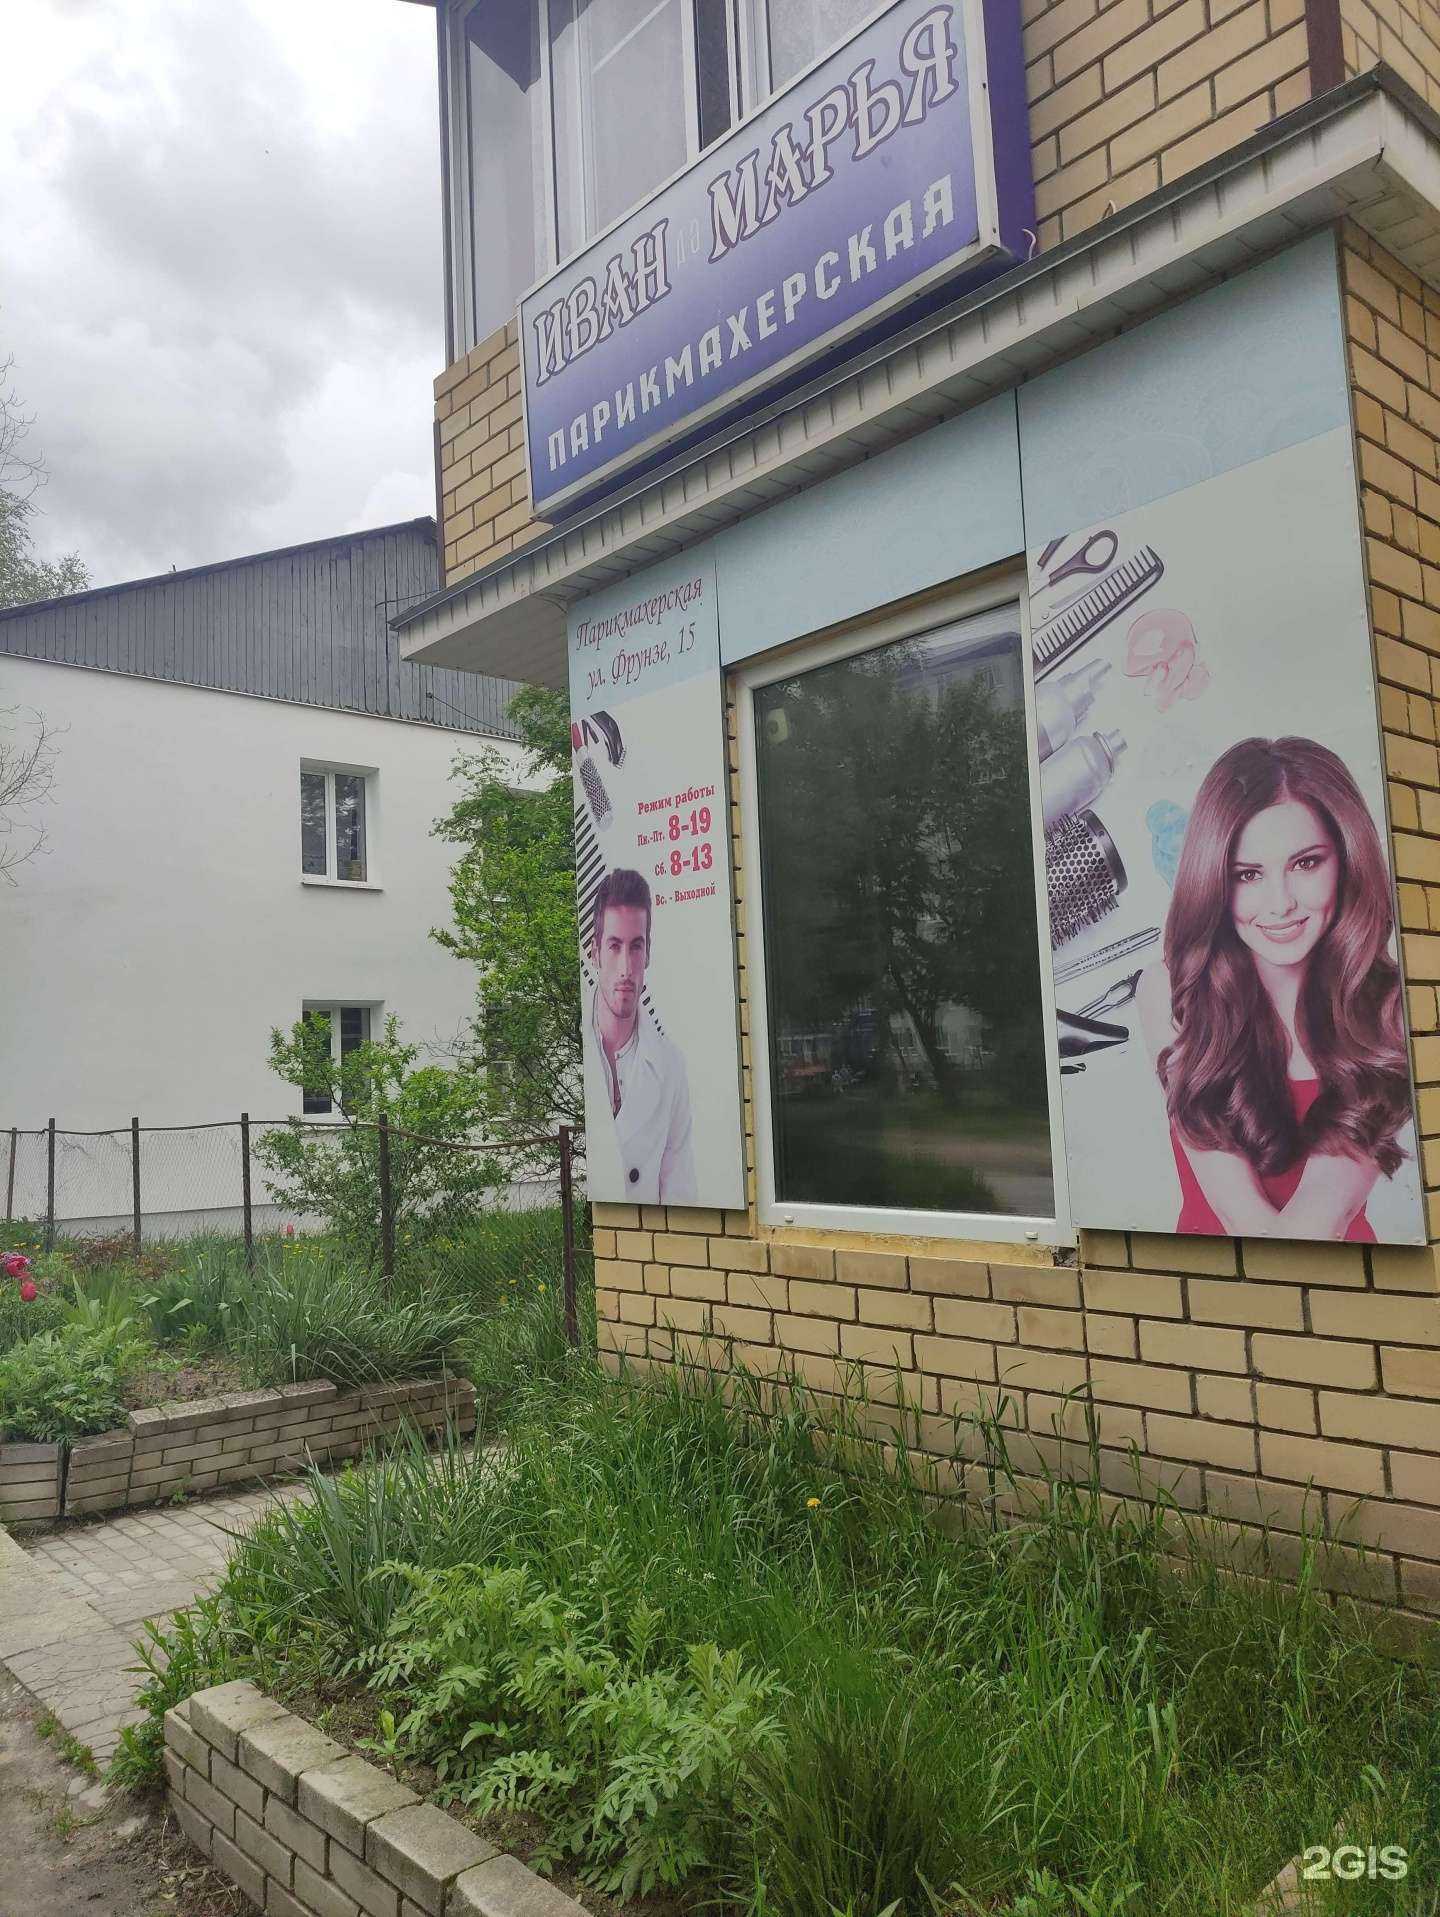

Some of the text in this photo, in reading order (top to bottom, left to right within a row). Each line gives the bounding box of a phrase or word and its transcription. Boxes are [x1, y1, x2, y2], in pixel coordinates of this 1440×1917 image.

[533, 218, 671, 387] ИВАН
[707, 4, 960, 264] МАРЬЯ
[547, 174, 956, 472] ПАРИКМАХЕРСКАЯ
[576, 577, 703, 651] Парикмахерская
[586, 620, 696, 701] ул. Фрунзе, 15
[637, 784, 715, 816] Режим работы
[668, 806, 712, 841] 8-19
[670, 842, 713, 877] 8-13
[674, 880, 717, 903] Выходной
